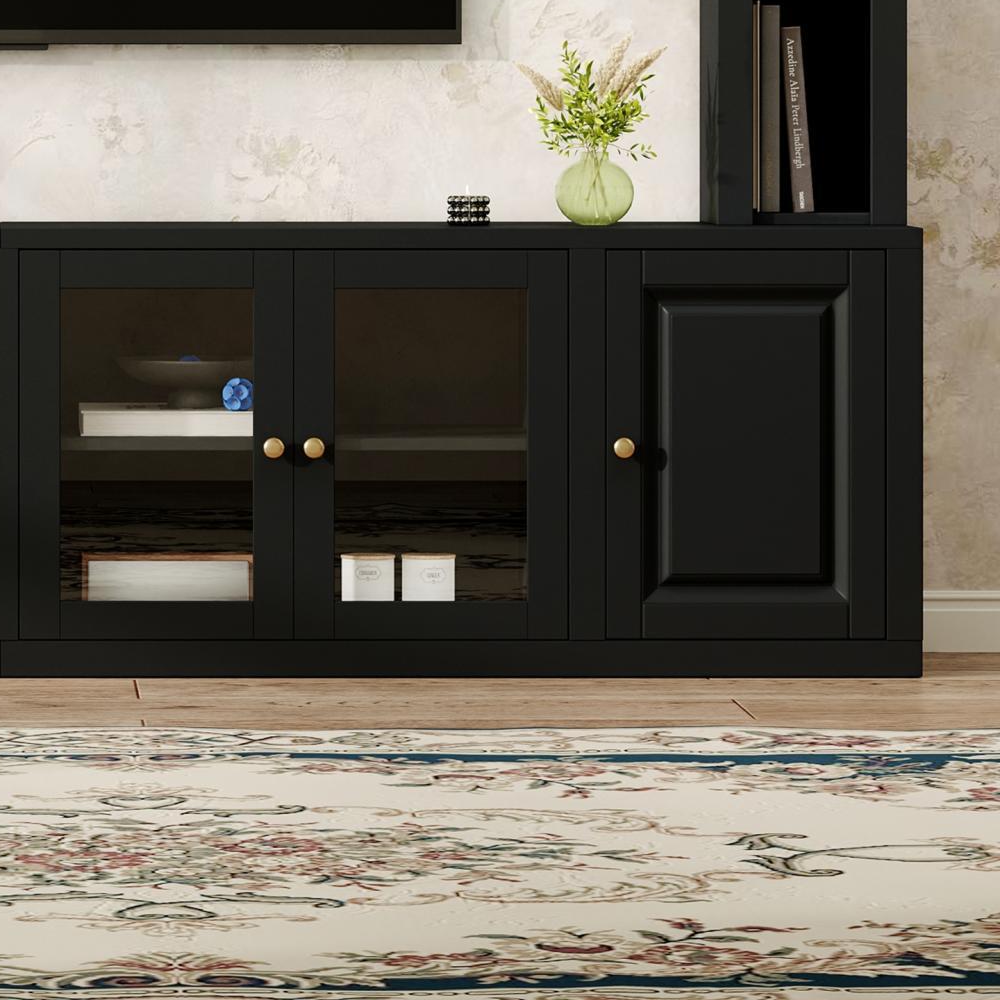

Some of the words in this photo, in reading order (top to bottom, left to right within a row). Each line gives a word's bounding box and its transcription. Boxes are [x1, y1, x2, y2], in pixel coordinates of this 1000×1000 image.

[786, 38, 797, 77] Azzedine
[791, 105, 801, 126] Peter
[793, 128, 805, 169] Lindbergh
